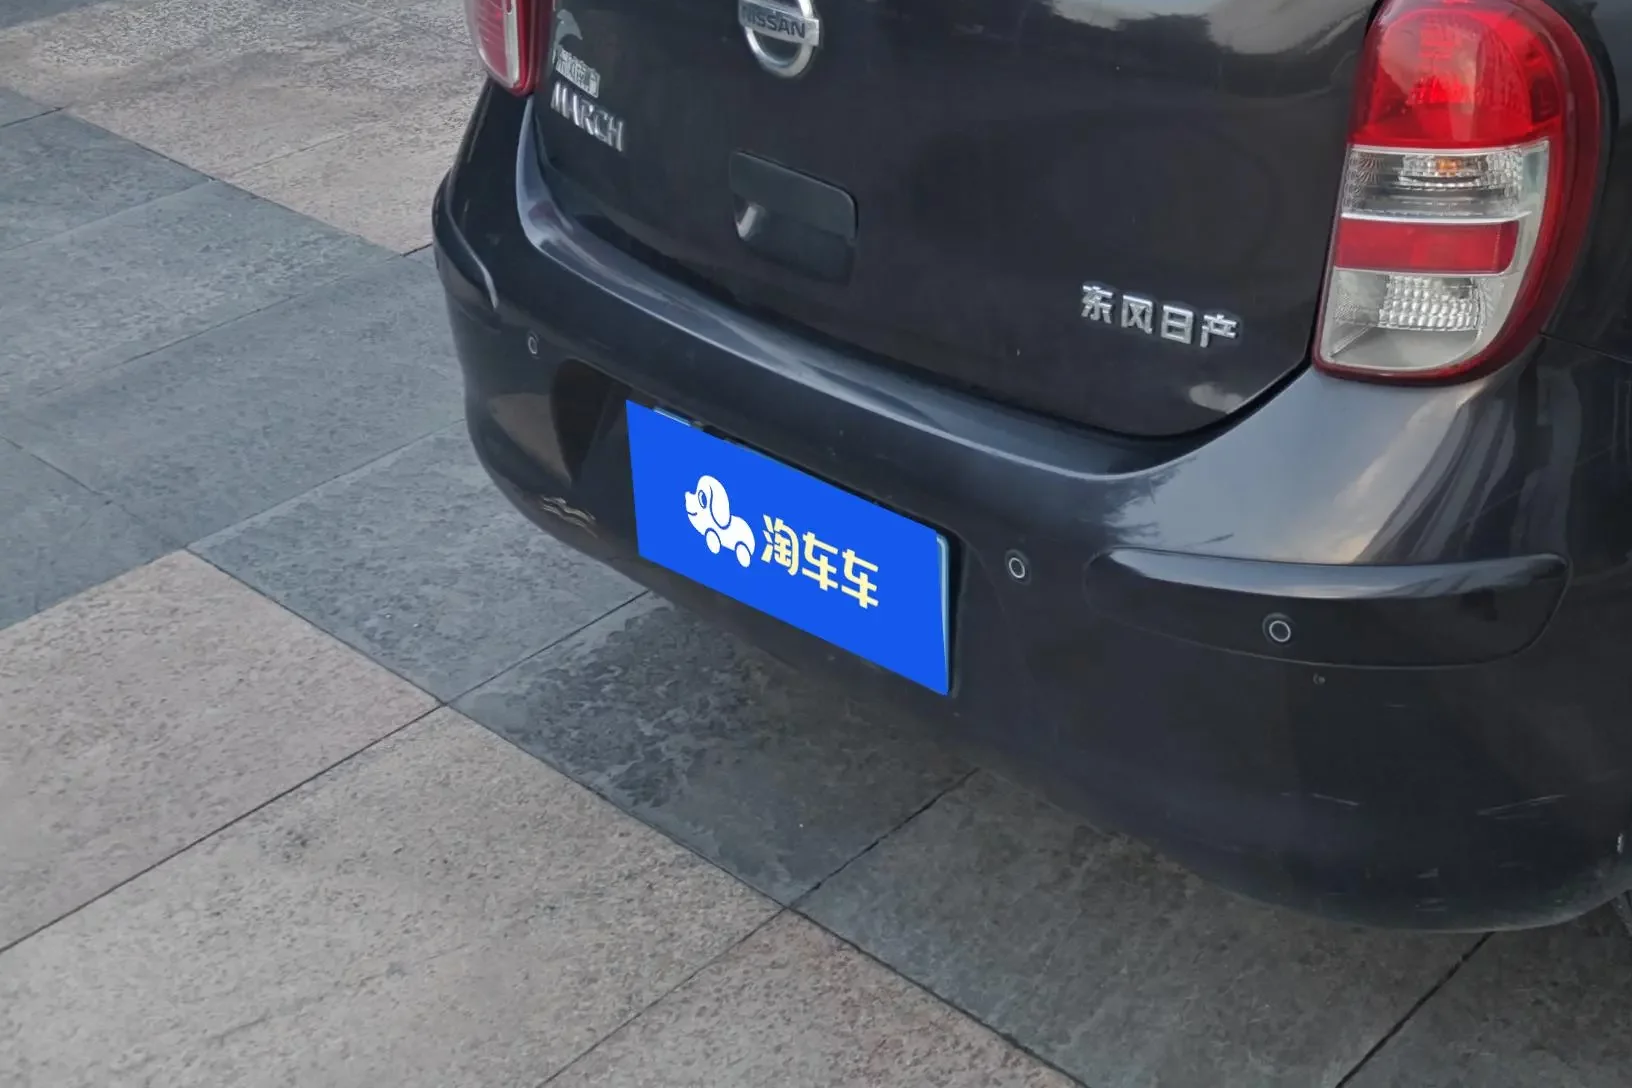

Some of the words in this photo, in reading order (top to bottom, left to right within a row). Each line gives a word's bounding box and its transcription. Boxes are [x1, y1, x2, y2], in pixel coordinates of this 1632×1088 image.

[742, 4, 806, 39] NISSAN
[550, 80, 624, 152] MARCH
[1081, 284, 1238, 348] 东风日产
